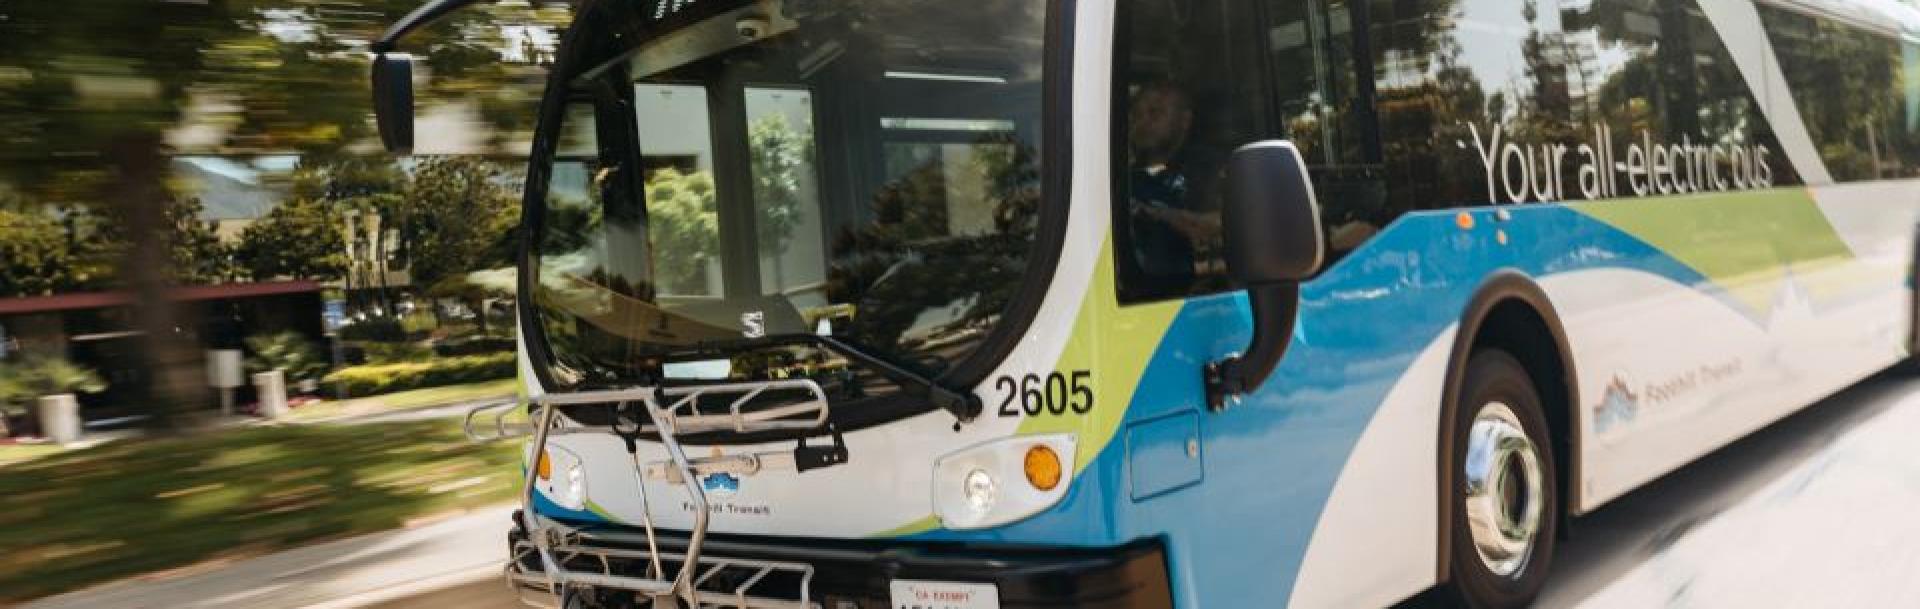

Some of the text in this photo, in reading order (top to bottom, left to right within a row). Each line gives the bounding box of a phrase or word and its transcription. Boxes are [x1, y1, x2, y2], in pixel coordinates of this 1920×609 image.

[1466, 121, 1566, 204] Your
[1579, 119, 1728, 200] all-electric
[995, 369, 1093, 417] 2605
[727, 503, 769, 514] Transit
